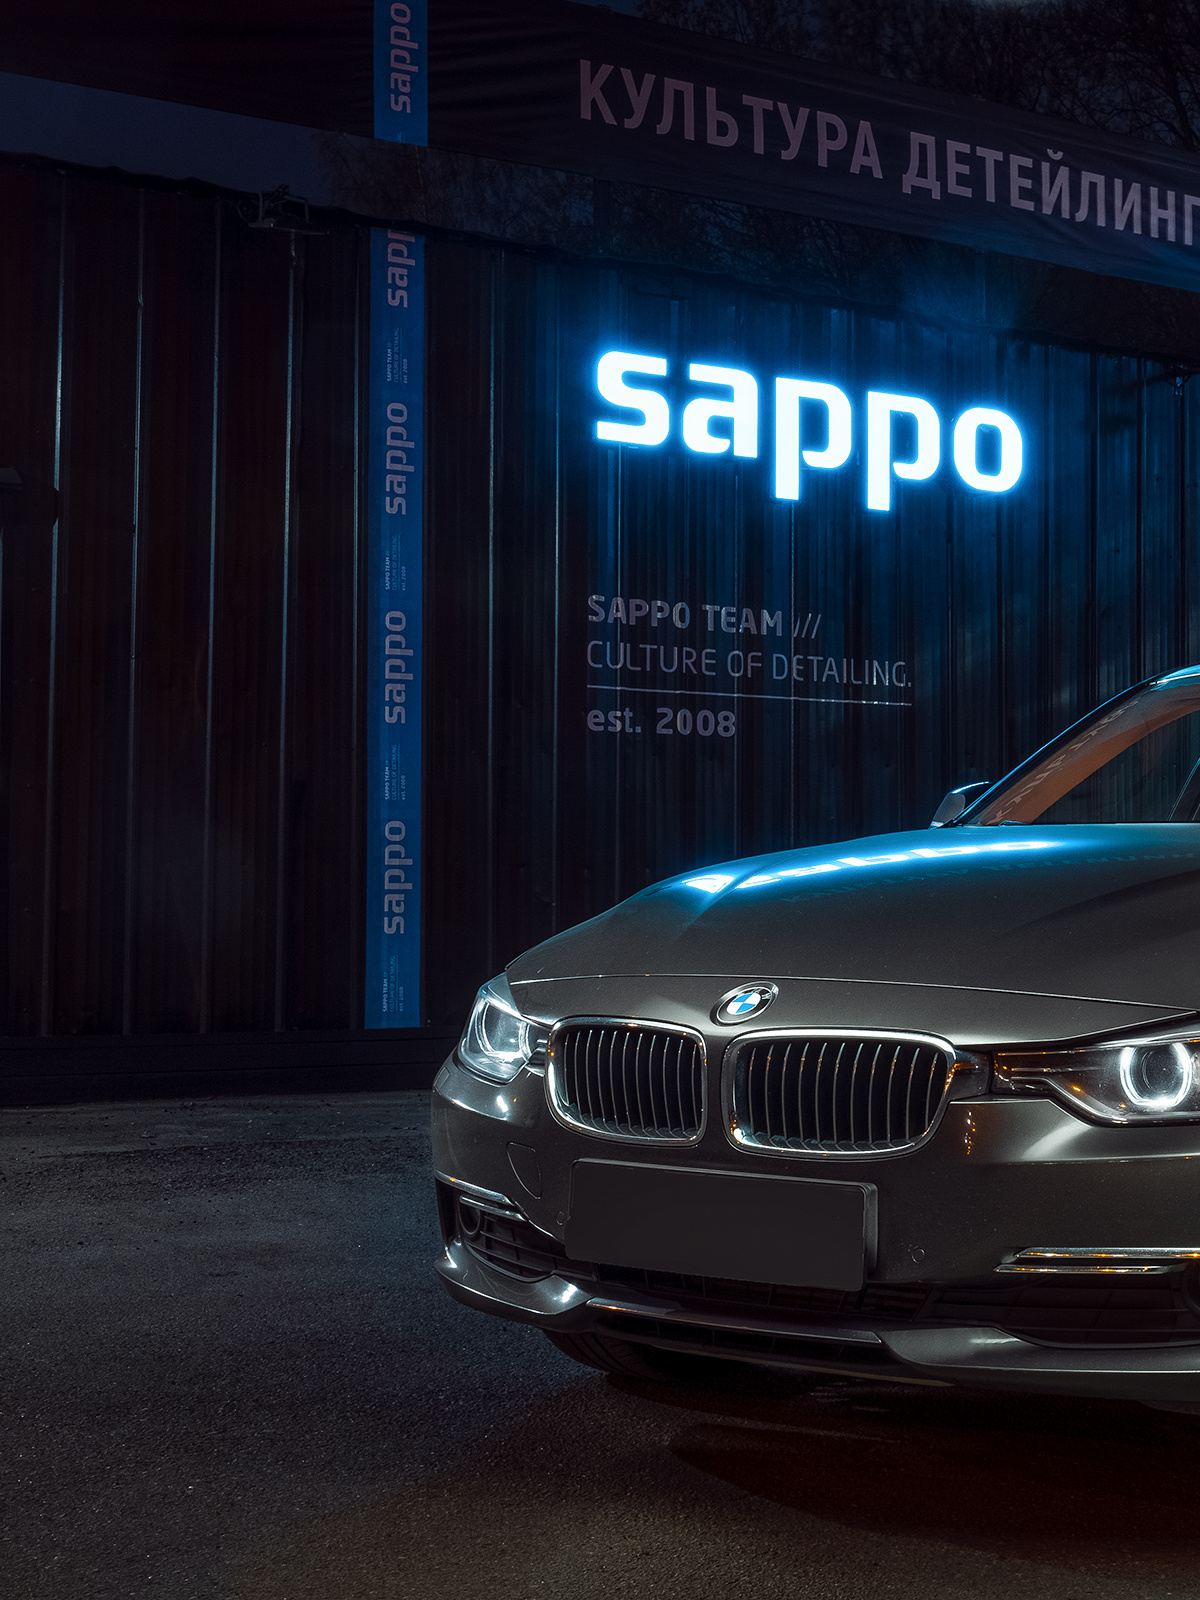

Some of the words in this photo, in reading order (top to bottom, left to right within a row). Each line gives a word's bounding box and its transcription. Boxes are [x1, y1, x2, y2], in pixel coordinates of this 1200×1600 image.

[390, 2, 419, 114] sappo
[579, 58, 884, 180] КУЛЬТУРА
[385, 402, 415, 515] sappo
[596, 350, 1024, 512] sappo
[384, 610, 414, 724] sappo
[586, 640, 717, 676] CULTURE
[727, 650, 763, 679] OF
[772, 653, 912, 688] DETAILING.
[587, 594, 690, 629] SAPPO
[701, 603, 783, 637] TEAM
[586, 707, 642, 734] est.
[655, 706, 737, 738] 2008
[383, 820, 413, 935] sappo
